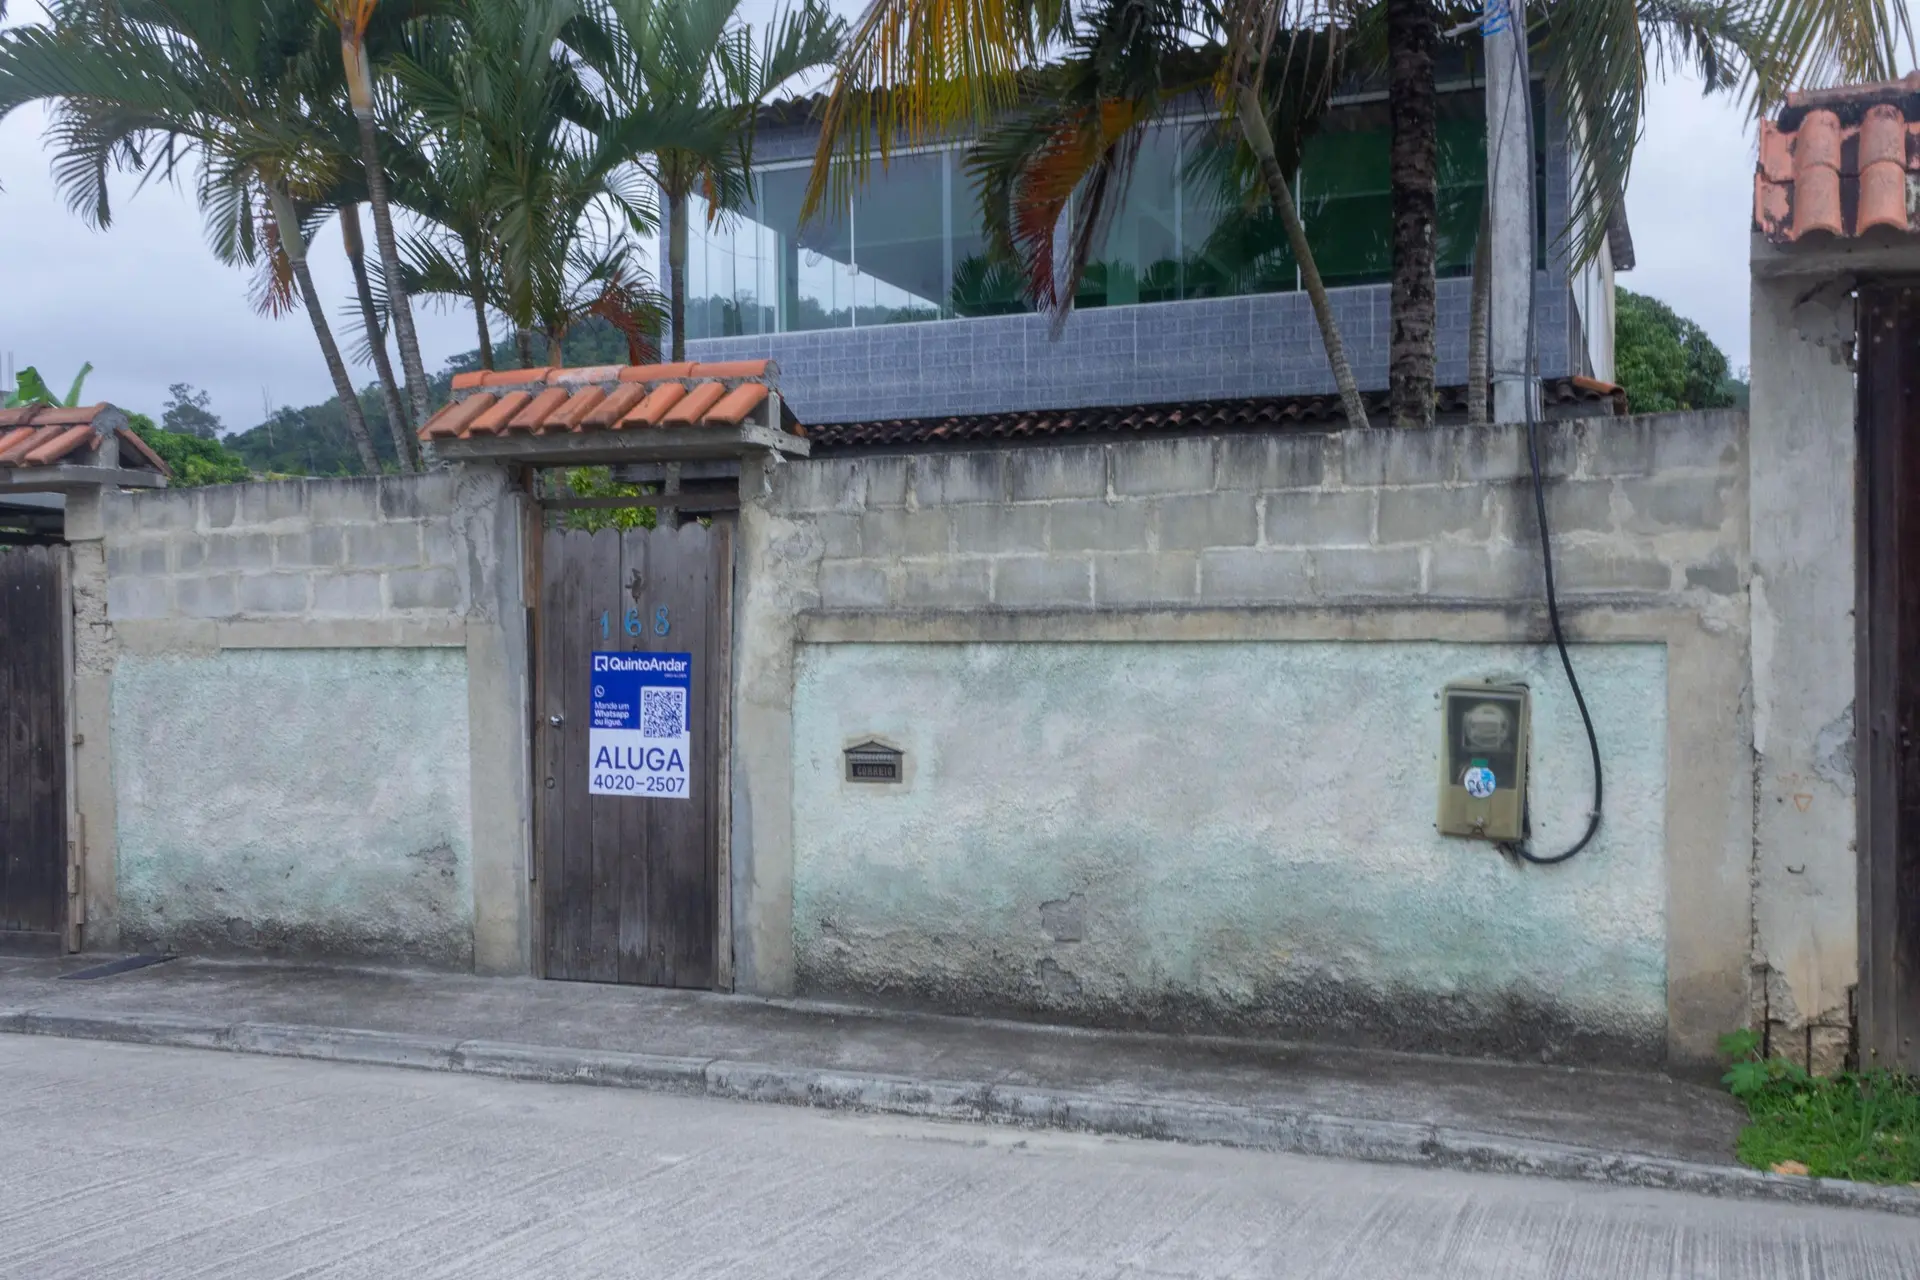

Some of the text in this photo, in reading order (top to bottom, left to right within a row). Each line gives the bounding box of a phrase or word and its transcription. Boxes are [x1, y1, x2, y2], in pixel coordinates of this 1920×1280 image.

[600, 604, 670, 640] 168
[609, 656, 687, 671] QuintoAndar
[595, 702, 617, 710] Mande
[595, 710, 629, 719] Whatsapp
[604, 718, 622, 727] ligue.
[595, 746, 684, 772] ALUGA
[594, 774, 685, 792] 4020-2507
